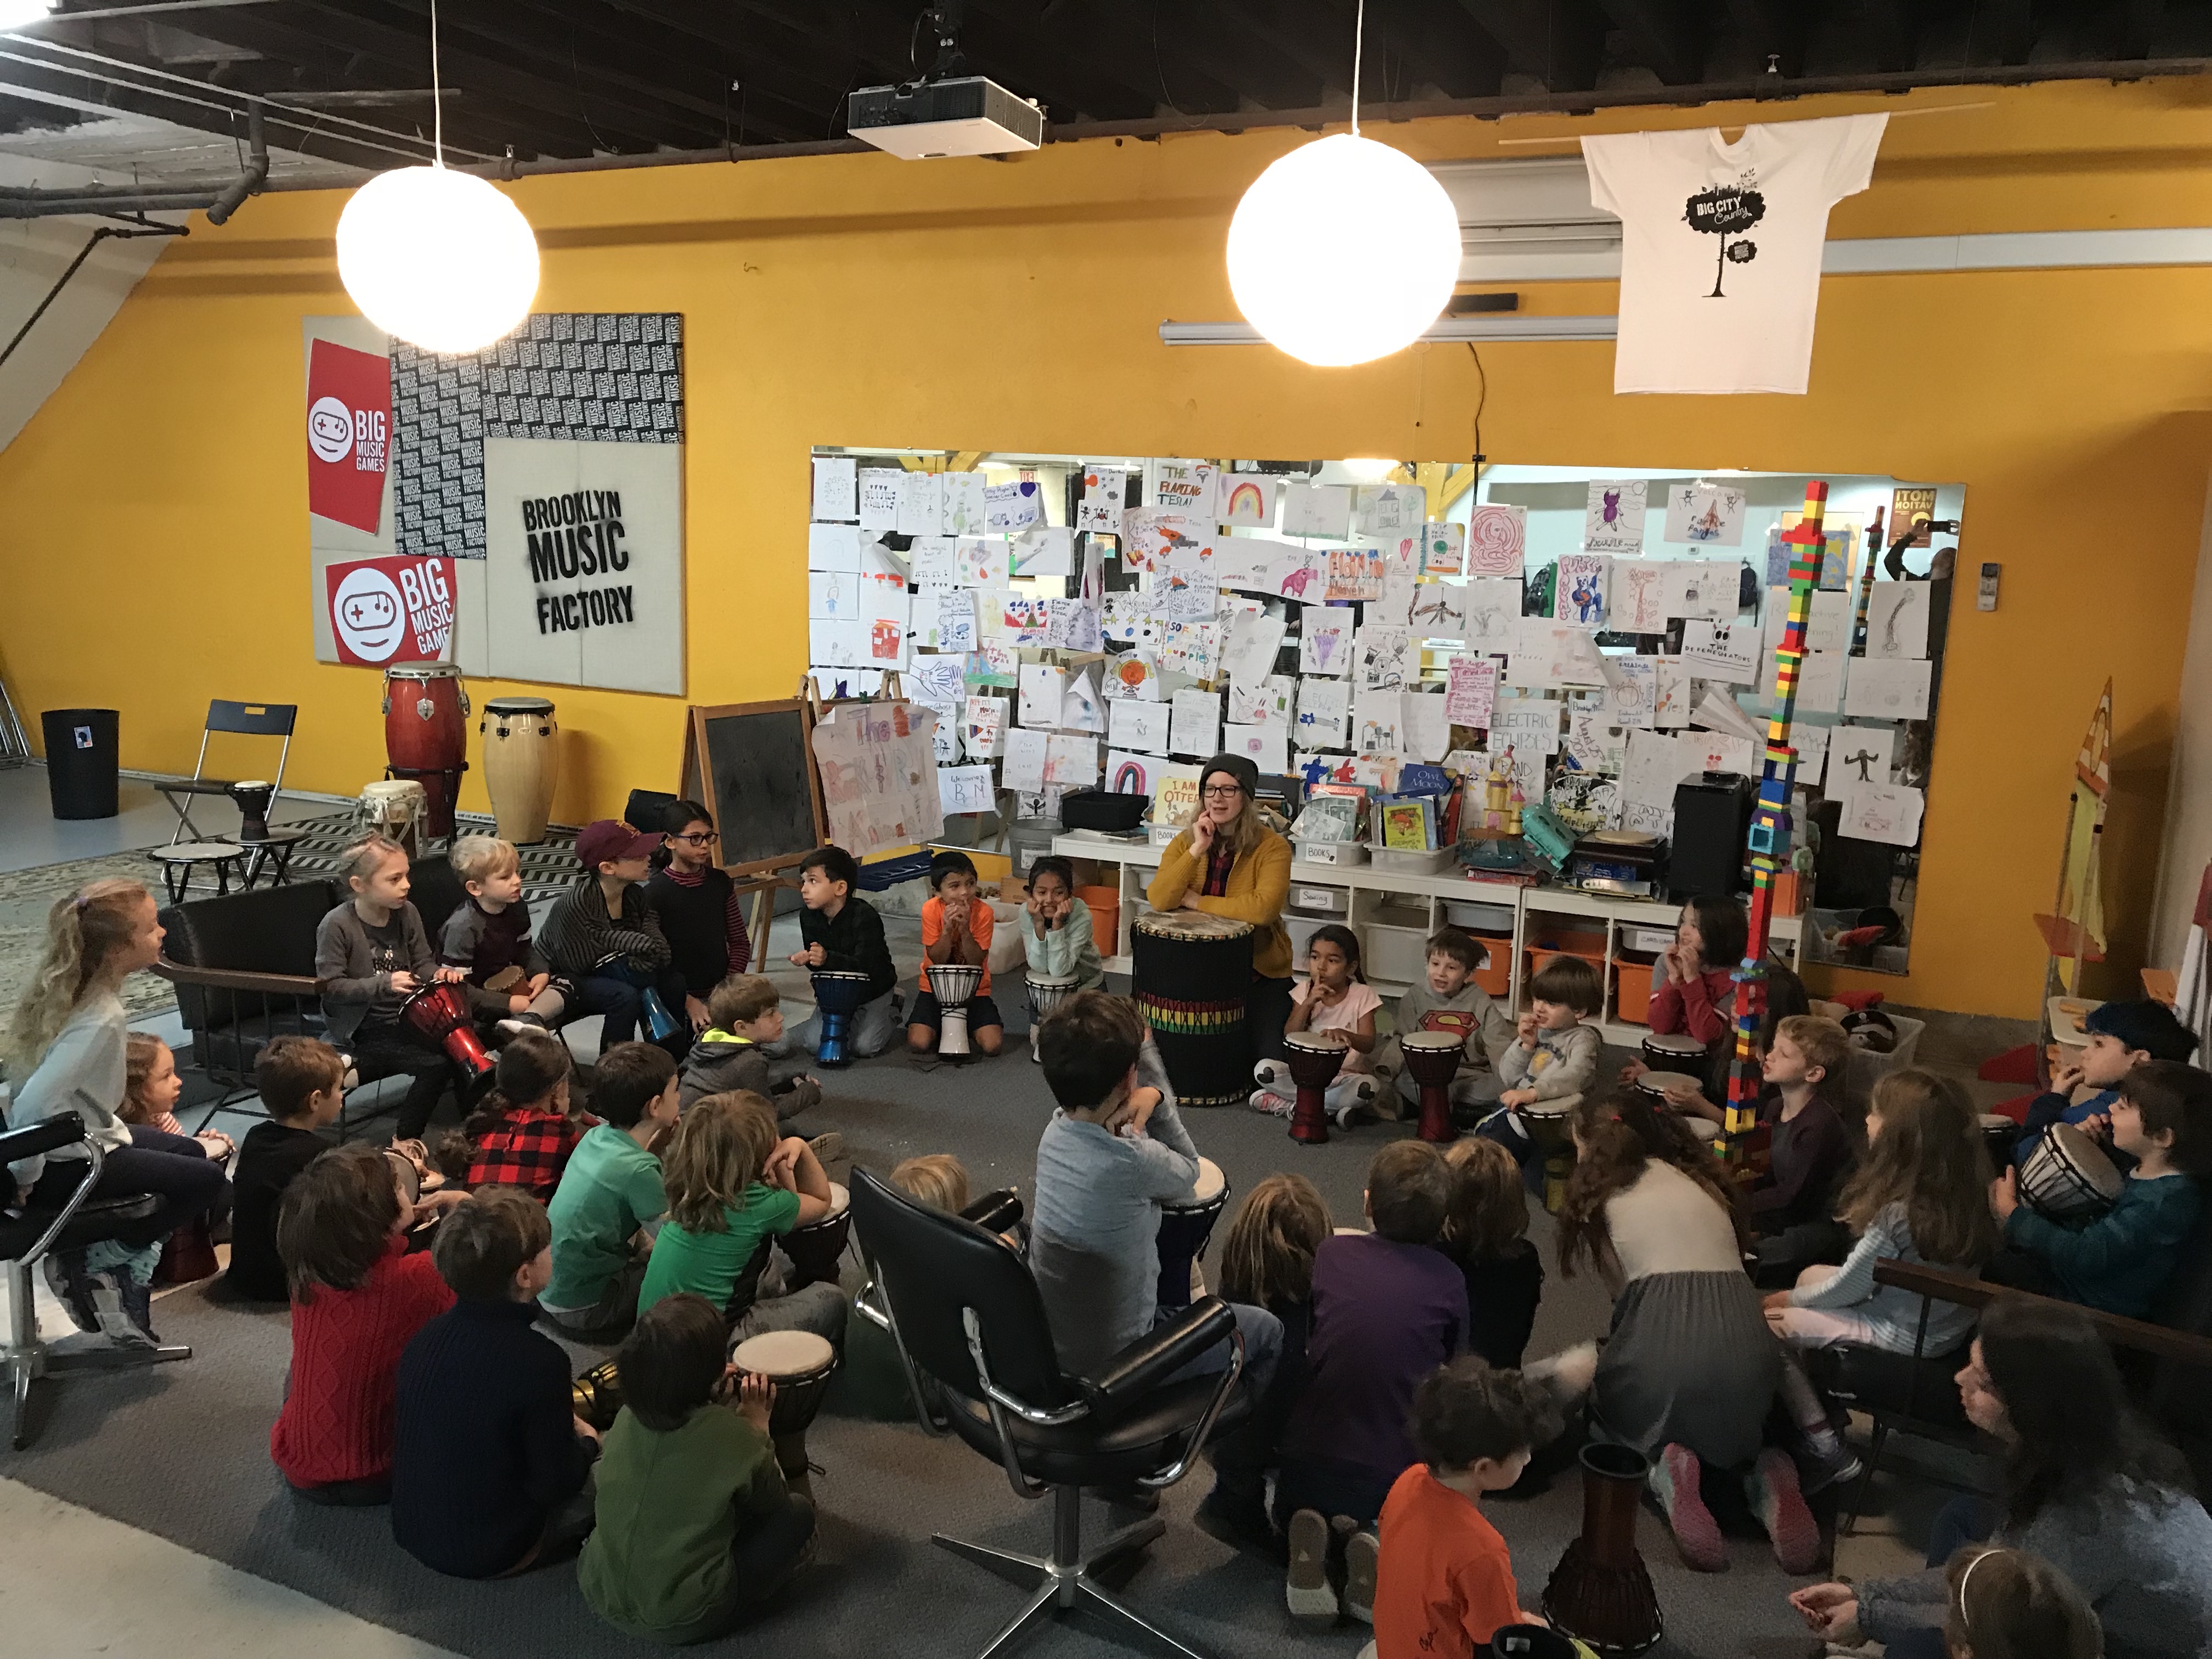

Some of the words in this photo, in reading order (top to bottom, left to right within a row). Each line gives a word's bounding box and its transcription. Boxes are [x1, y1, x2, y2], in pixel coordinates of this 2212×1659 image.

[1697, 202, 1715, 216] BIG
[1716, 196, 1741, 212] CITY
[580, 315, 589, 341] MUSIC
[602, 315, 611, 341] MUSIC
[624, 316, 633, 342] MUSIC
[647, 316, 656, 342] MUSIC
[670, 316, 680, 343] MUSIC
[399, 349, 416, 362] MUSIC
[503, 340, 512, 365] MUSIC
[523, 341, 533, 367] MUSIC
[545, 342, 555, 368] MUSIC
[567, 343, 577, 368] MUSIC
[589, 343, 599, 369] MUSIC
[611, 344, 622, 370] MUSIC
[634, 345, 644, 371] MUSIC
[657, 345, 668, 371] MUSIC
[419, 364, 437, 375] MUSIC
[439, 377, 458, 390] MUSIC
[577, 371, 587, 397] MUSIC
[599, 372, 610, 398] MUSIC
[621, 373, 633, 399] MUSIC
[644, 374, 656, 399] MUSIC
[668, 375, 680, 401] MUSIC
[460, 391, 481, 404] MUSIC
[503, 396, 514, 421] MUSIC
[400, 404, 419, 416] MUSIC
[440, 405, 459, 417] MUSIC
[524, 397, 534, 422] MUSIC
[545, 398, 556, 423] MUSIC
[567, 399, 577, 424] MUSIC
[589, 400, 599, 425] MUSIC
[611, 401, 622, 427] MUSIC
[633, 402, 644, 428] MUSIC
[656, 403, 668, 429] MUSIC
[356, 410, 385, 442] BIG
[420, 418, 438, 430] MUSIC
[402, 431, 419, 443] MUSIC
[441, 432, 459, 444] MUSIC
[357, 442, 385, 458] MUSIC
[421, 444, 439, 457] MUSIC
[461, 446, 482, 459] MUSIC
[357, 458, 385, 473] GAMES
[442, 459, 460, 471] MUSIC
[1162, 466, 1189, 479] THE
[462, 473, 483, 486] MUSIC
[442, 486, 461, 497] MUSIC
[404, 510, 422, 522] MUSIC
[464, 500, 484, 512] MUSIC
[522, 490, 622, 532] BROOKLYN
[424, 524, 442, 536] MUSIC
[464, 527, 485, 539] MUSIC
[405, 537, 424, 548] MUSIC
[445, 539, 464, 550] MUSIC
[527, 521, 629, 584] MUSIC
[399, 558, 449, 613] BIG
[410, 601, 453, 635] MUSIC
[536, 585, 634, 634] FACTORY
[417, 627, 449, 654] GAME
[1492, 713, 1554, 728] ELECTRIC
[1493, 732, 1551, 751] ECLIPSES
[1570, 737, 1588, 759] 2017
[1172, 781, 1177, 790] I
[1182, 781, 1197, 791] AM
[1410, 778, 1444, 790] MOON
[1418, 770, 1441, 781] OWL
[1308, 847, 1330, 858] BOOKS
[1582, 879, 1611, 889] CLUE
[1303, 891, 1327, 905] Sewing
